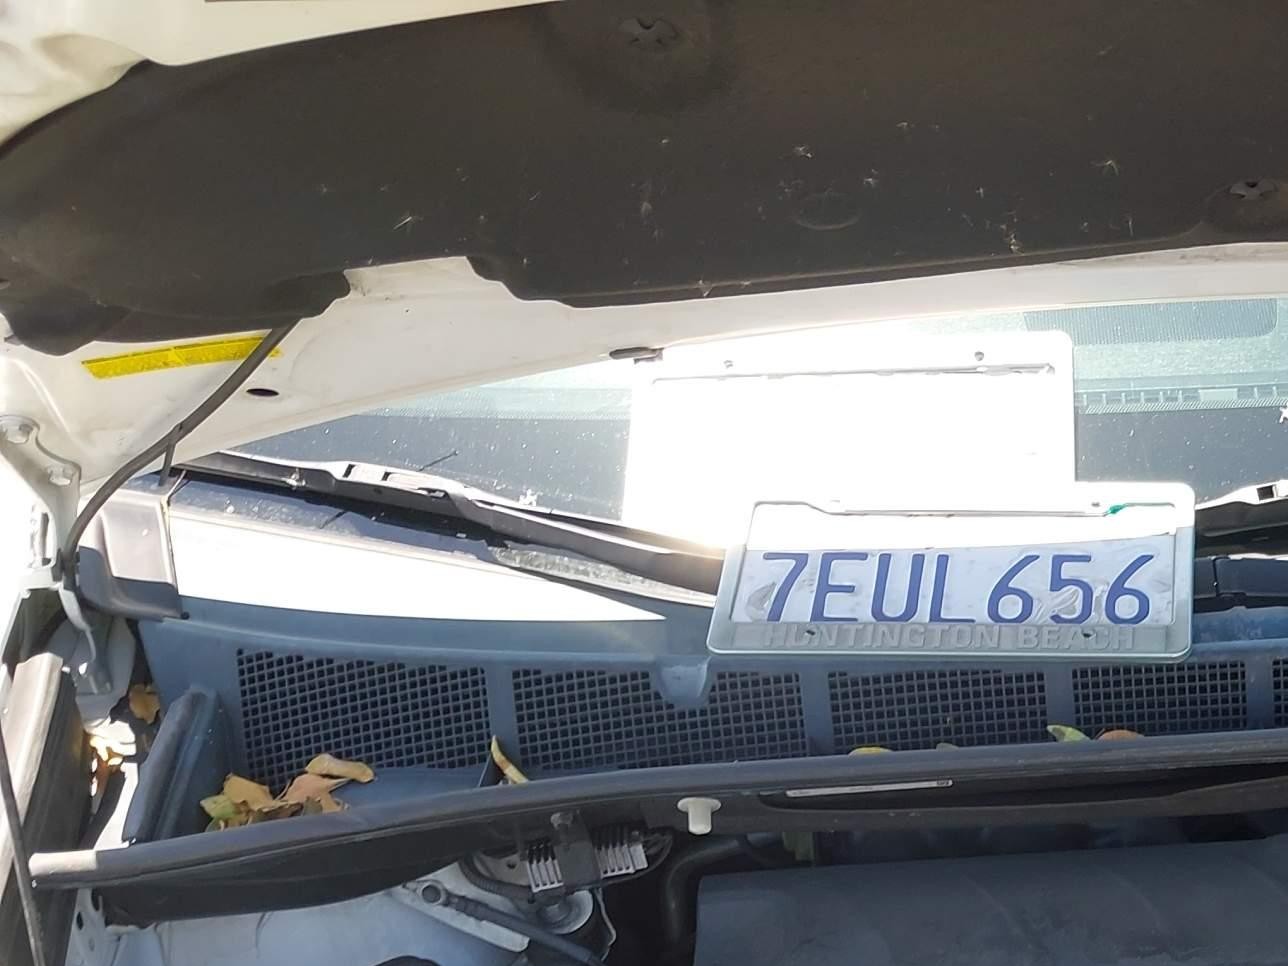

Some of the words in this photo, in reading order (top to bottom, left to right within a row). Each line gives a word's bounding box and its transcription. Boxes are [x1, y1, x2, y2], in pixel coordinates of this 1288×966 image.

[763, 552, 1153, 624] 7EUL656
[764, 623, 999, 649] HUNTINGTON
[1017, 625, 1134, 650] BEACH
